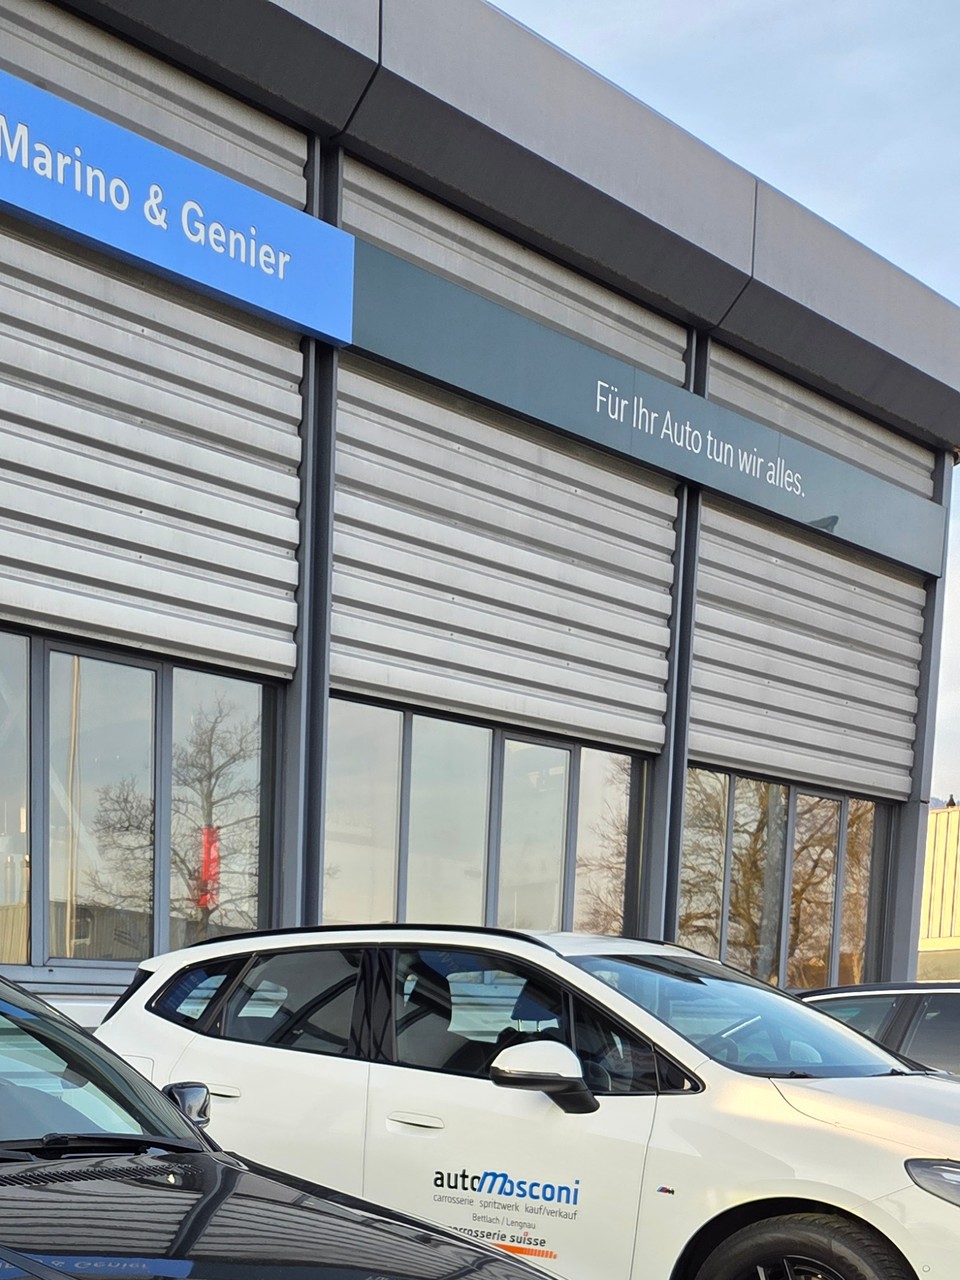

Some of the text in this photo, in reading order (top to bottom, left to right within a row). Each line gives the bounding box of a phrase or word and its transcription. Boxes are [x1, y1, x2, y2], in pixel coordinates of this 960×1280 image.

[142, 183, 168, 230] &
[181, 200, 292, 280] Genier
[596, 380, 805, 497] Für Ihr Auto tun wir alles.
[433, 1194, 578, 1220] carrosserie spritzwerk kauf/verkauf
[472, 1212, 500, 1224] Bettlach
[506, 1217, 536, 1230] Lengnau
[509, 1231, 546, 1247] suisse
